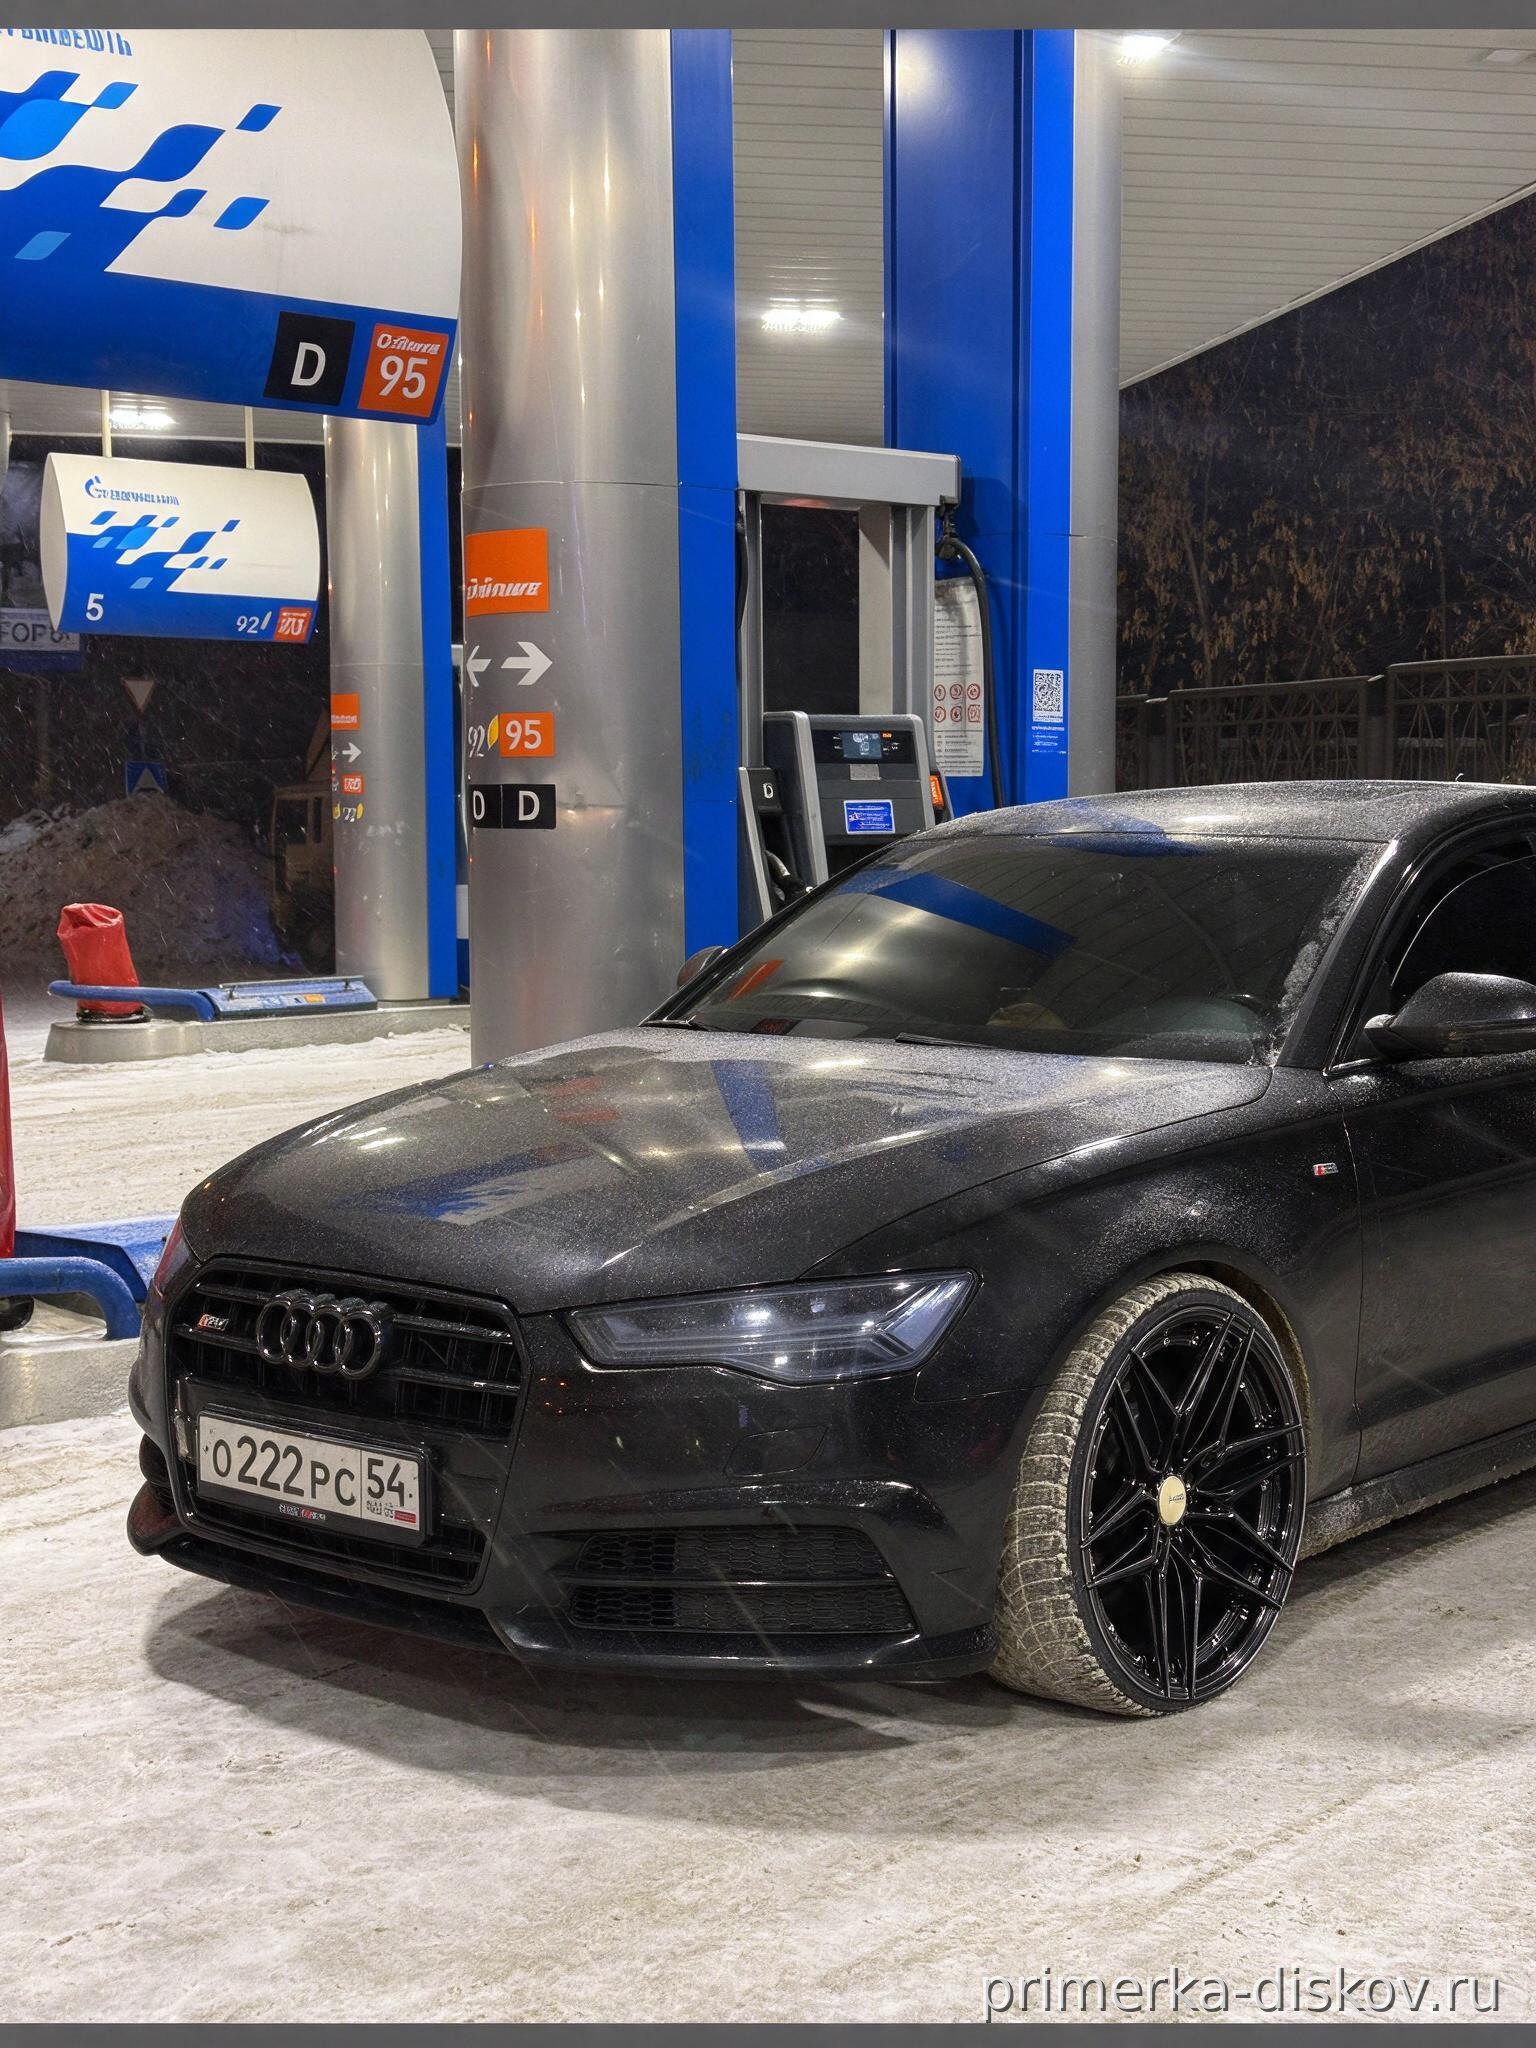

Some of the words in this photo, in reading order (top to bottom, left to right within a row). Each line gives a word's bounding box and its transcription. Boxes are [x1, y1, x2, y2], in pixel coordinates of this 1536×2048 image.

[291, 341, 326, 386] D
[378, 354, 429, 399] 95
[86, 592, 104, 621] 5
[236, 615, 260, 634] 92
[505, 720, 542, 750] 95
[518, 790, 540, 821] D
[367, 1457, 405, 1507] 54
